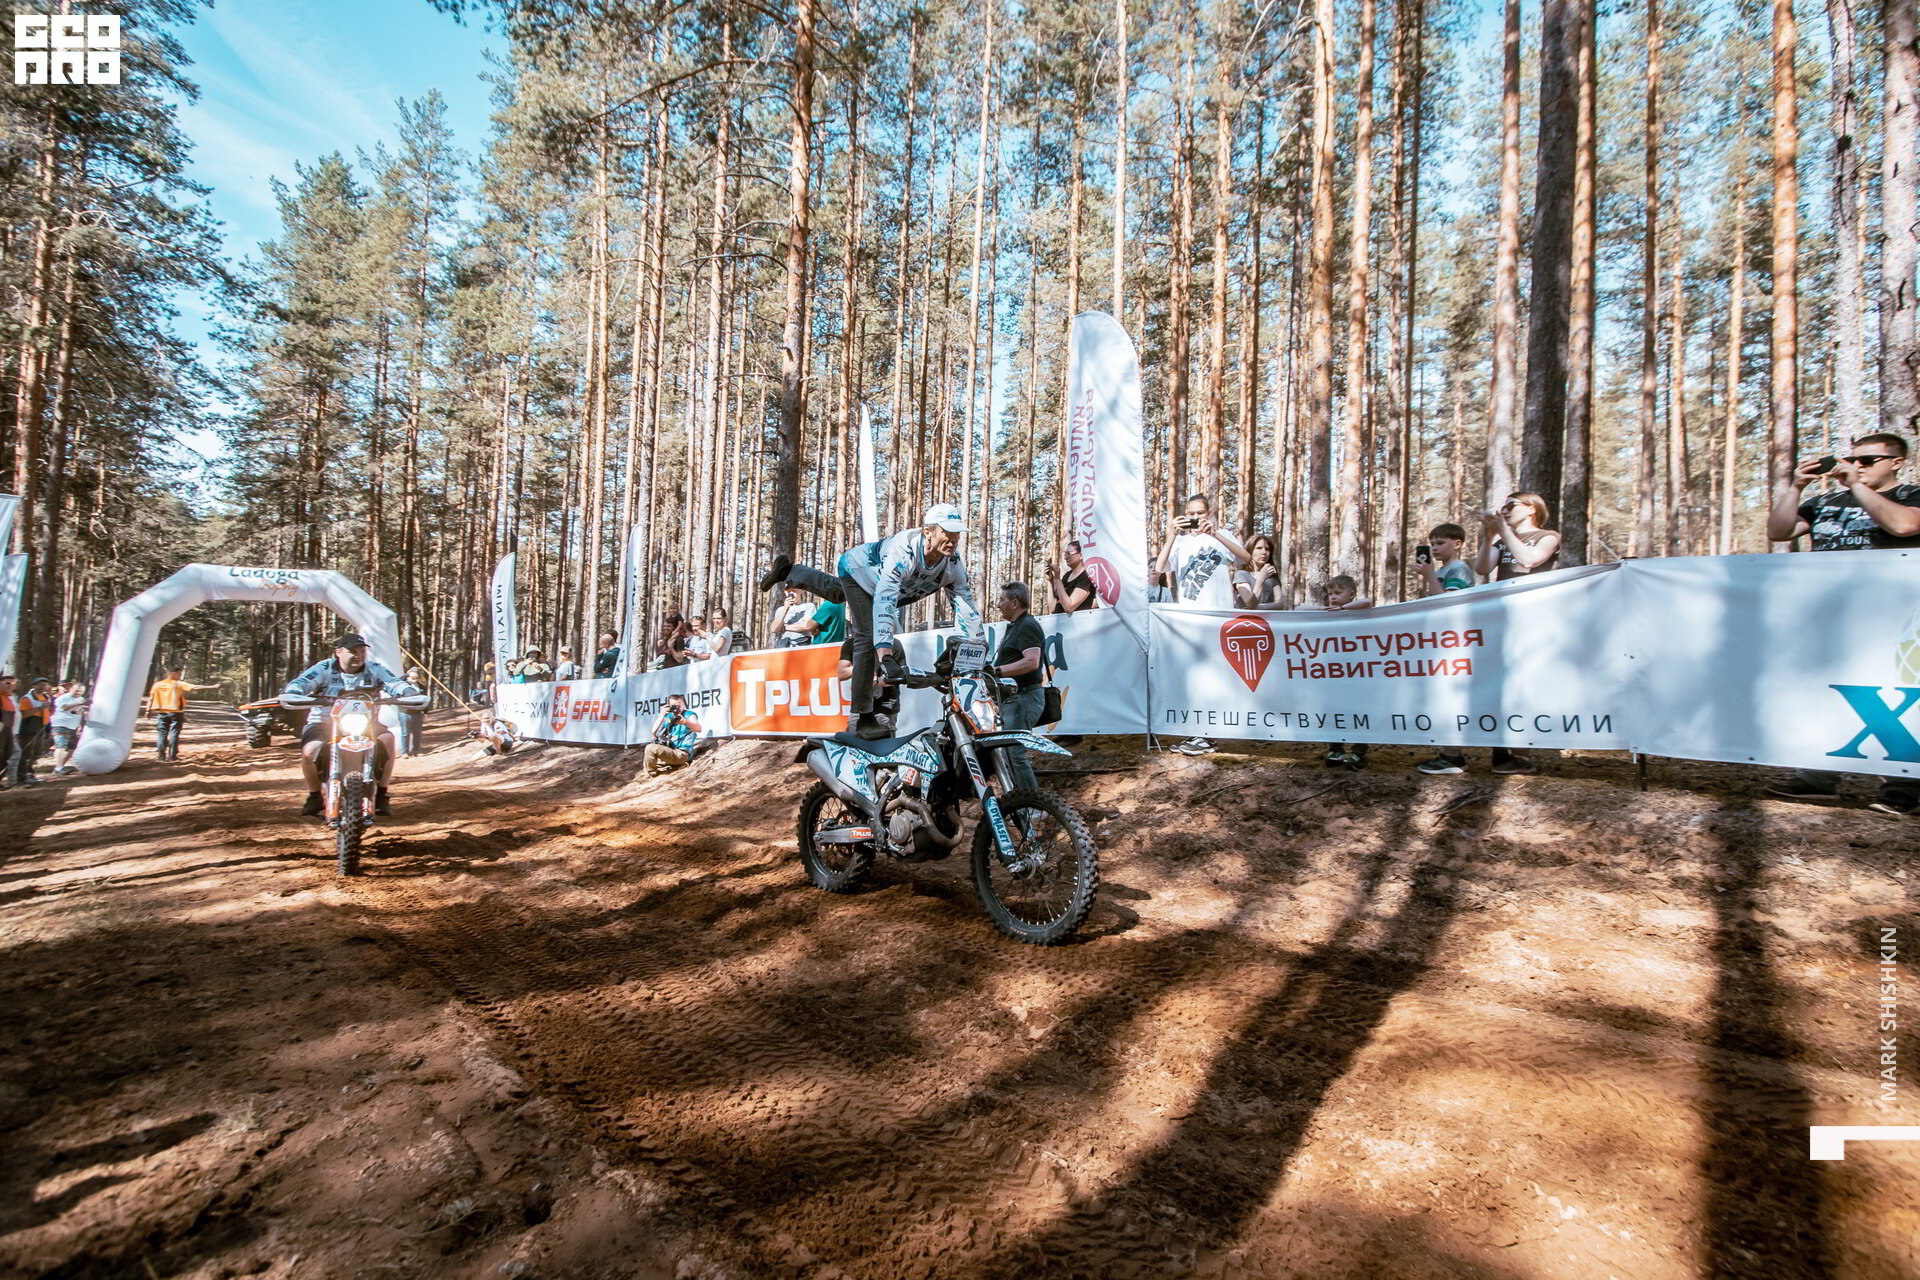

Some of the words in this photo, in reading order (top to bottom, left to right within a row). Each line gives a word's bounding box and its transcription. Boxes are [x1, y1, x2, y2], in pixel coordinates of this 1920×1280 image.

[1840, 536, 1871, 545] TOUR
[229, 568, 299, 584] Ladoga
[1284, 629, 1484, 658] Культурная
[1287, 658, 1473, 679] Навигация
[634, 689, 721, 717] PATHNDER
[959, 678, 978, 712] 7
[572, 699, 617, 722] SPRU
[1166, 709, 1370, 730] ПУТЕШЕСТВУЕМ
[1391, 714, 1432, 731] ПО
[1456, 714, 1612, 733] РОССИИ
[830, 747, 847, 778] 7
[990, 808, 1010, 843] DYNASET
